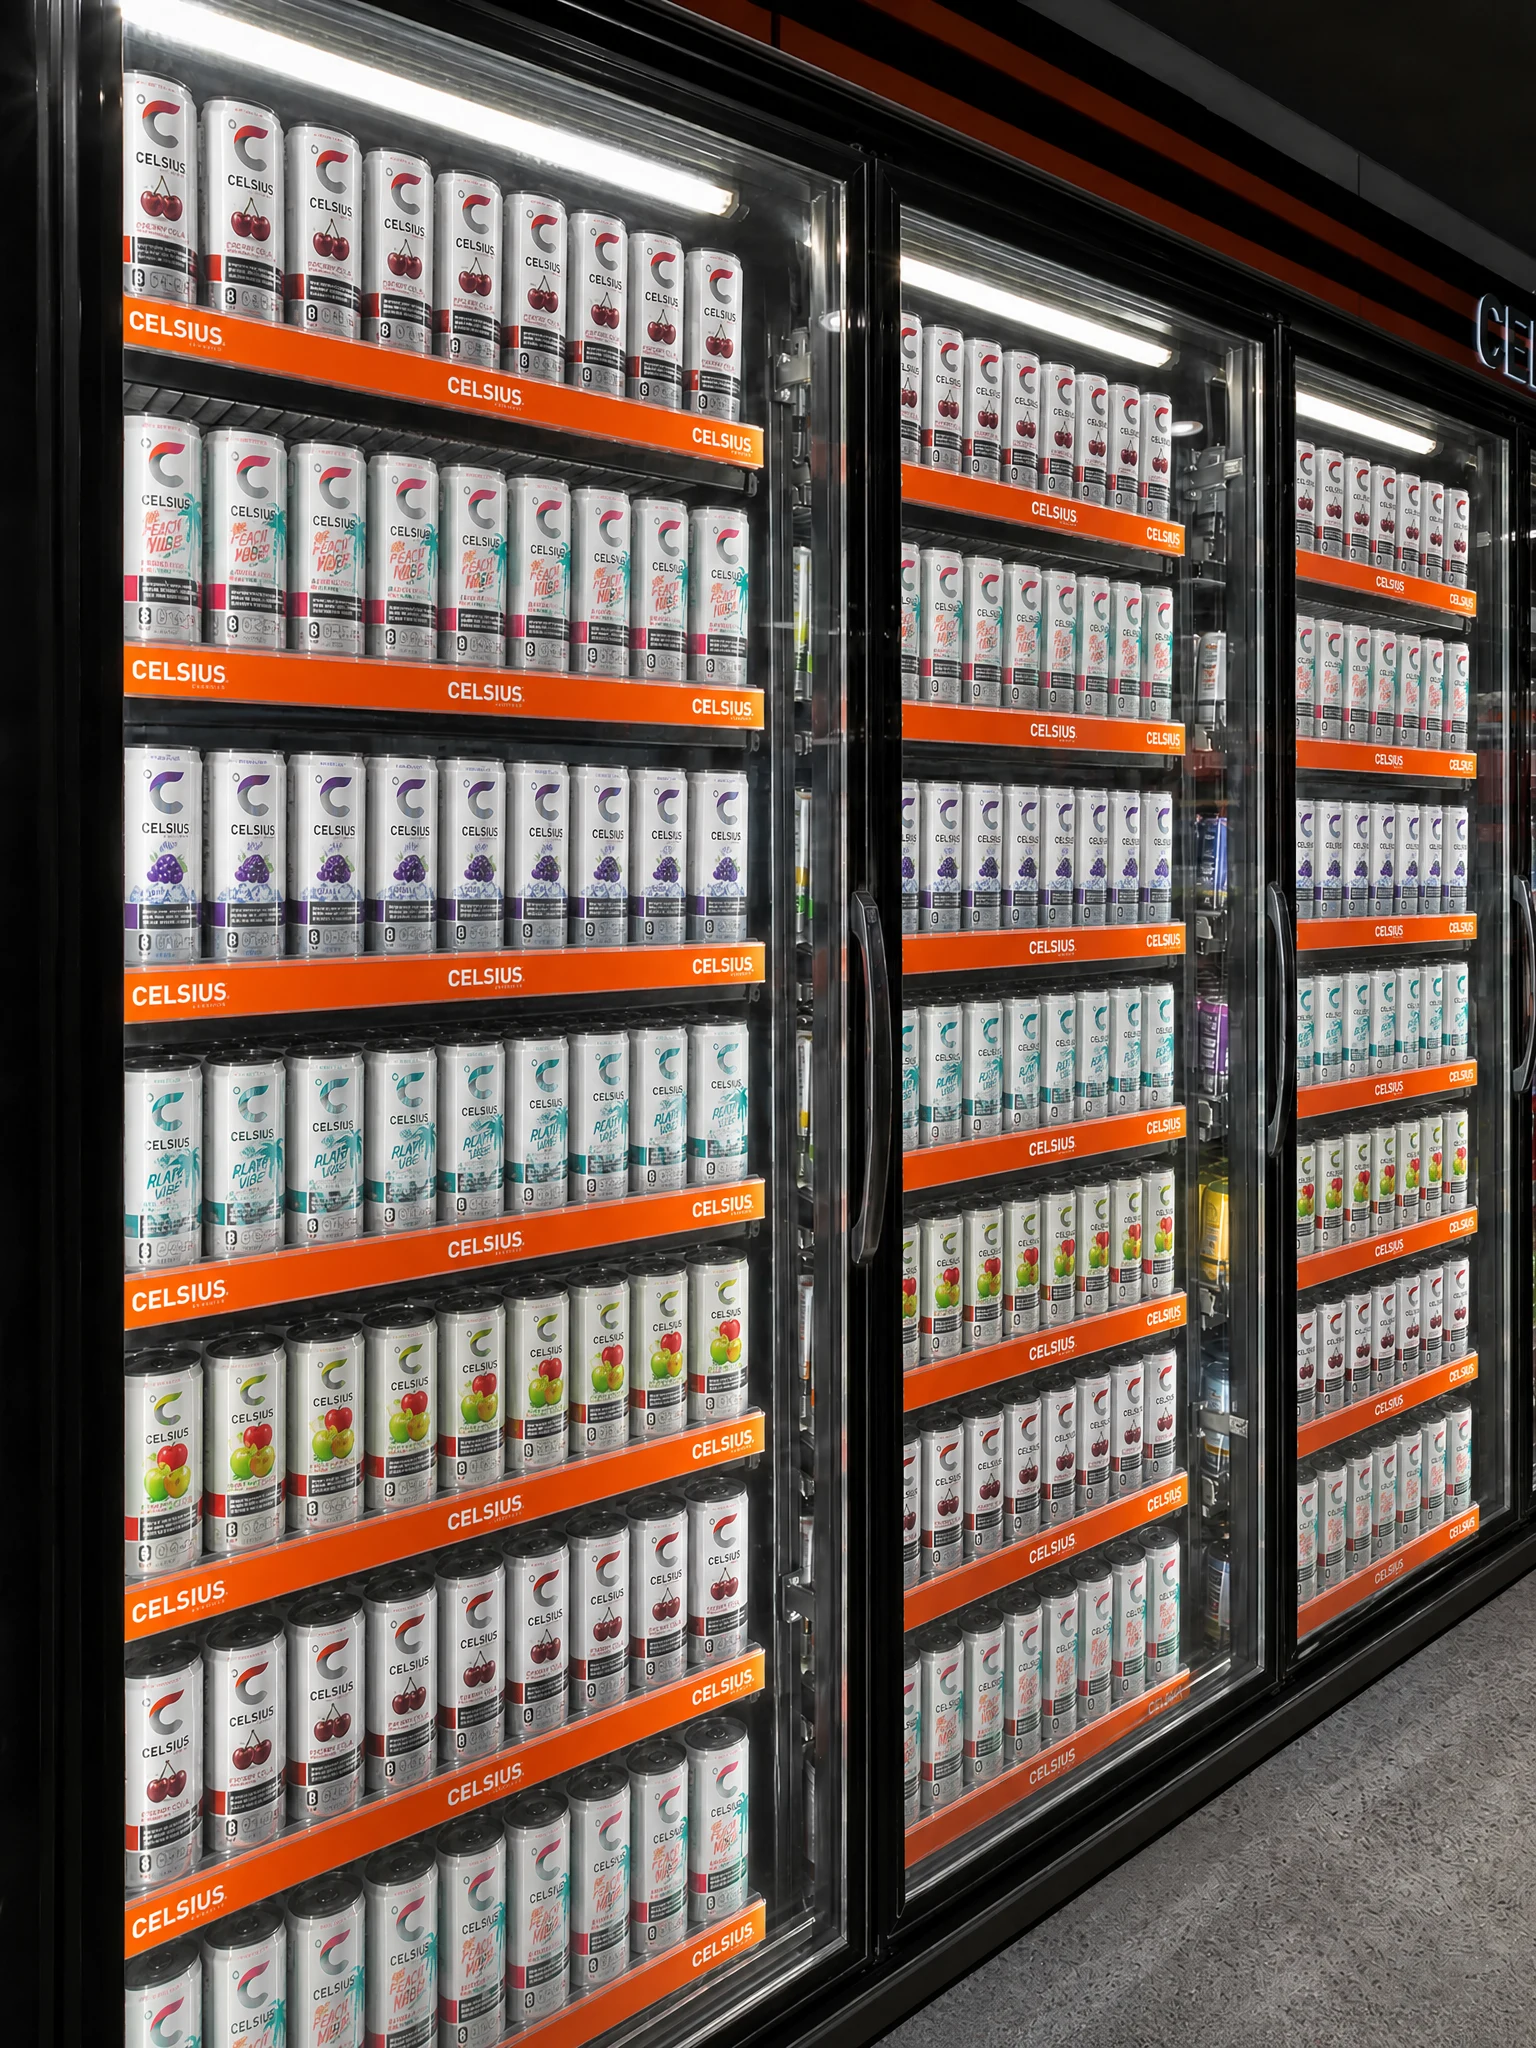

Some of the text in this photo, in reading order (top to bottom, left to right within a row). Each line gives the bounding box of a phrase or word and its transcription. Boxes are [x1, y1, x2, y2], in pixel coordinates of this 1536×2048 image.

[136, 152, 186, 174] CELSIUS
[227, 174, 274, 195] CELSIUS
[309, 197, 352, 217] CELSIUS
[384, 218, 425, 237] CELSIUS
[129, 310, 222, 345] CELSIUS
[448, 377, 522, 405] CELSIUS
[692, 428, 752, 452] CELSIUS
[1032, 501, 1077, 523] CELSIUS
[1146, 527, 1180, 545] CELSIUS
[132, 660, 225, 683] CELSIUS
[448, 682, 522, 702] CELSIUS
[692, 699, 752, 716] CELSIUS
[1030, 723, 1076, 737] CELSIUS
[1146, 732, 1180, 746] CELSIUS
[142, 823, 189, 834] CELSIUS
[231, 824, 274, 836] CELSIUS
[314, 825, 355, 836] CELSIUS
[390, 825, 430, 836] CELSIUS
[1029, 940, 1075, 954] CELSIUS
[1146, 933, 1180, 948] CELSIUS
[692, 957, 753, 975] CELSIUS
[448, 967, 522, 987] CELSIUS
[132, 982, 226, 1006] CELSIUS
[312, 1120, 353, 1132] CELSIUS
[390, 1113, 428, 1125] CELSIUS
[1146, 1117, 1180, 1135] CELSIUS
[144, 1137, 189, 1151] CELSIUS
[231, 1129, 274, 1142] CELSIUS
[1029, 1136, 1075, 1156] CELSIUS
[692, 1194, 753, 1218] CELSIUS
[448, 1231, 522, 1258] CELSIUS
[132, 1280, 225, 1312] CELSIUS
[1146, 1305, 1180, 1326] CELSIUS
[1029, 1336, 1075, 1361] CELSIUS
[390, 1376, 428, 1391] CELSIUS
[313, 1393, 353, 1408] CELSIUS
[231, 1408, 274, 1424] CELSIUS
[145, 1428, 189, 1445] CELSIUS
[692, 1430, 753, 1459] CELSIUS
[1147, 1486, 1181, 1512] CELSIUS
[448, 1495, 522, 1531] CELSIUS
[1029, 1534, 1075, 1564] CELSIUS
[132, 1581, 225, 1623] CELSIUS
[389, 1656, 429, 1676] CELSIUS
[310, 1681, 353, 1702] CELSIUS
[692, 1669, 753, 1706] CELSIUS
[229, 1706, 274, 1727] CELSIUS
[142, 1736, 190, 1759] CELSIUS
[1029, 1748, 1076, 1785] CELSIUS
[447, 1763, 522, 1806] CELSIUS
[132, 1885, 225, 1939] CELSIUS
[692, 1922, 753, 1968] CELSIUS
